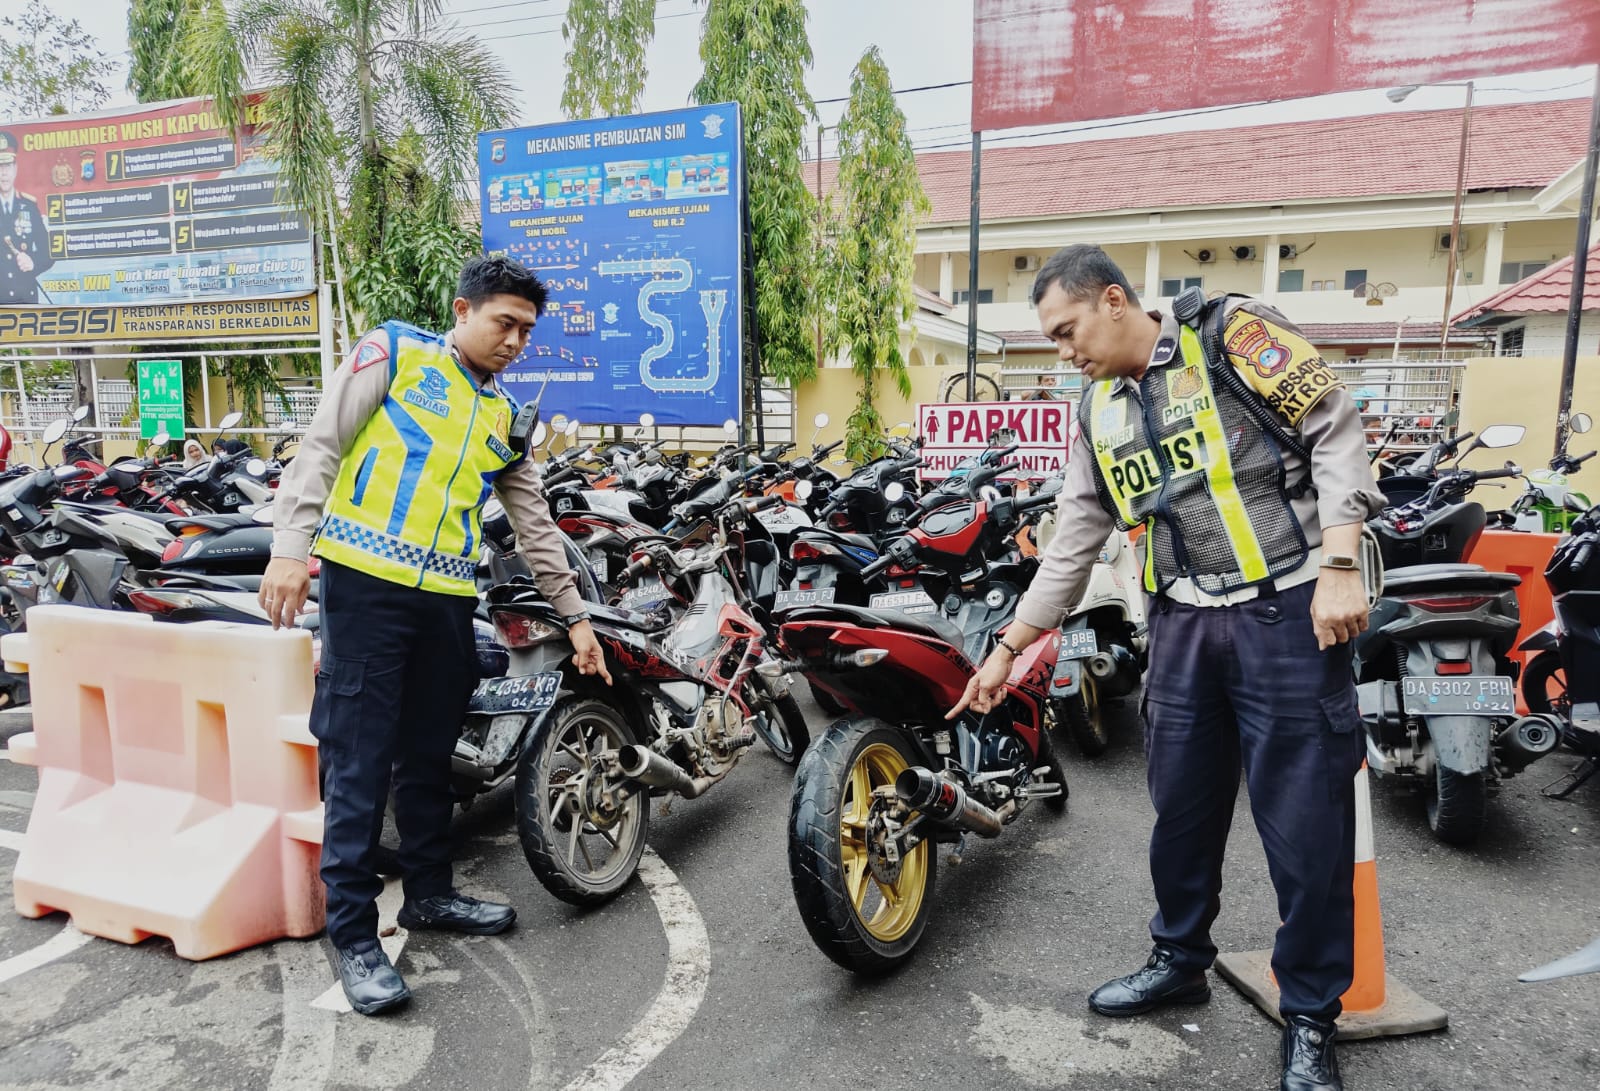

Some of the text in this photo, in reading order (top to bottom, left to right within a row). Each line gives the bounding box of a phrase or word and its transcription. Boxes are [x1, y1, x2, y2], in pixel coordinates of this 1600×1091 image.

[23, 125, 118, 152] COMMANDER
[121, 118, 163, 141] WISH
[527, 123, 686, 155] MEKANISME PEMBUATAN SIM
[110, 154, 118, 176] 1
[175, 188, 188, 208] 4
[49, 200, 61, 218] 2
[628, 204, 710, 218] MEKANISME UJIAN
[281, 221, 299, 230] 2024
[509, 214, 584, 228] MEKANISME UJIAN
[652, 219, 669, 228] SIM
[177, 226, 189, 244] 5
[525, 227, 567, 237] SIM MOBIL
[51, 235, 63, 253] 3
[83, 275, 111, 292] WIN
[115, 269, 142, 282] Work
[144, 268, 169, 281] Hard
[228, 262, 261, 276] Never
[263, 260, 288, 273] Give
[291, 258, 305, 272] Up
[193, 301, 310, 317] RESPONSIBILITAS
[0, 309, 117, 336] PRESISI
[123, 315, 311, 332] TRANSPARANSI BERKEADILAN
[1163, 396, 1211, 423] POLRI
[947, 408, 1062, 443] PARKIR
[1096, 428, 1131, 454] SANER
[1110, 431, 1209, 499] POLISI
[794, 591, 816, 602] 4573
[495, 678, 530, 697] 4354
[534, 675, 556, 693] KR
[1406, 680, 1510, 697] DA 6302 FBH
